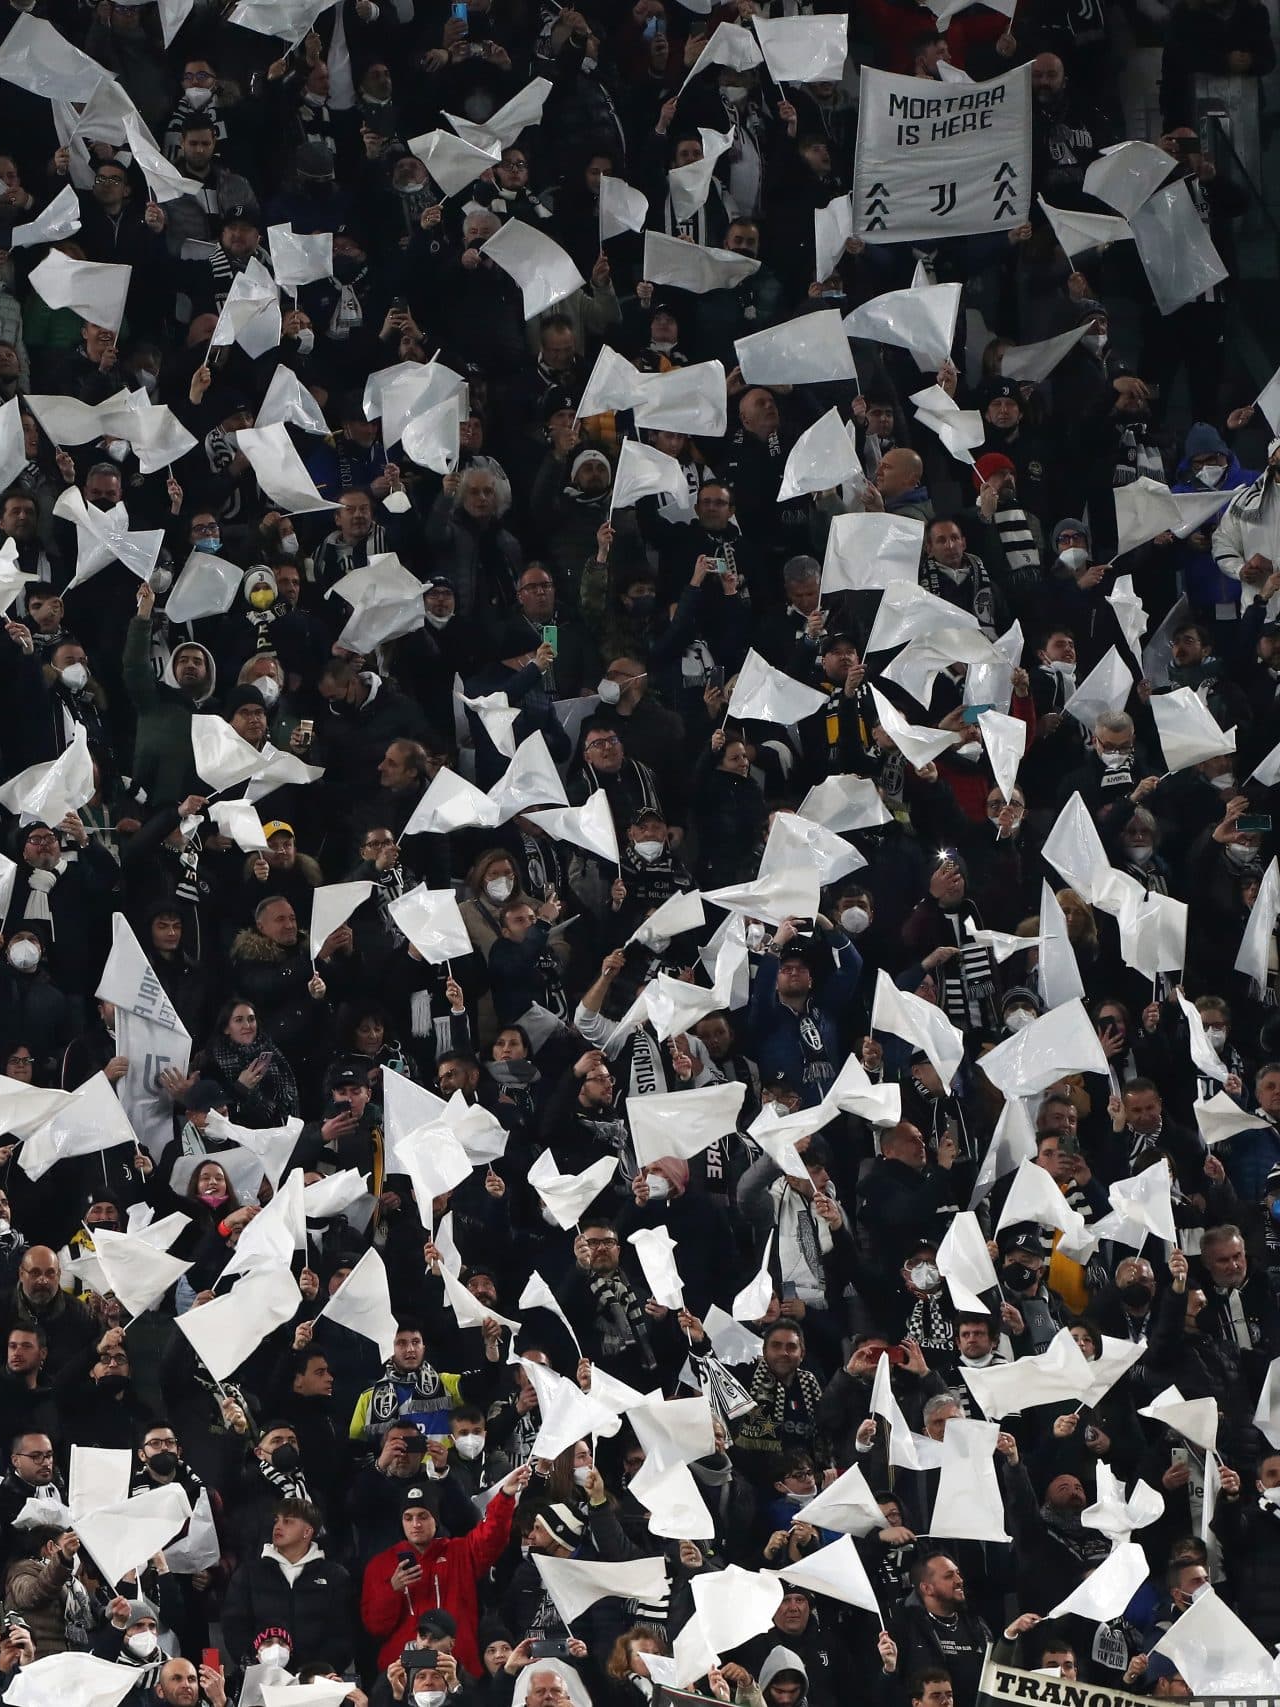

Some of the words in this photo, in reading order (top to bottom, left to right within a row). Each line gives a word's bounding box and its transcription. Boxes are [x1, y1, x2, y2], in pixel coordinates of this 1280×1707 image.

[889, 84, 1005, 120] MORTARA
[897, 125, 920, 146] IS
[931, 110, 993, 141] HERE
